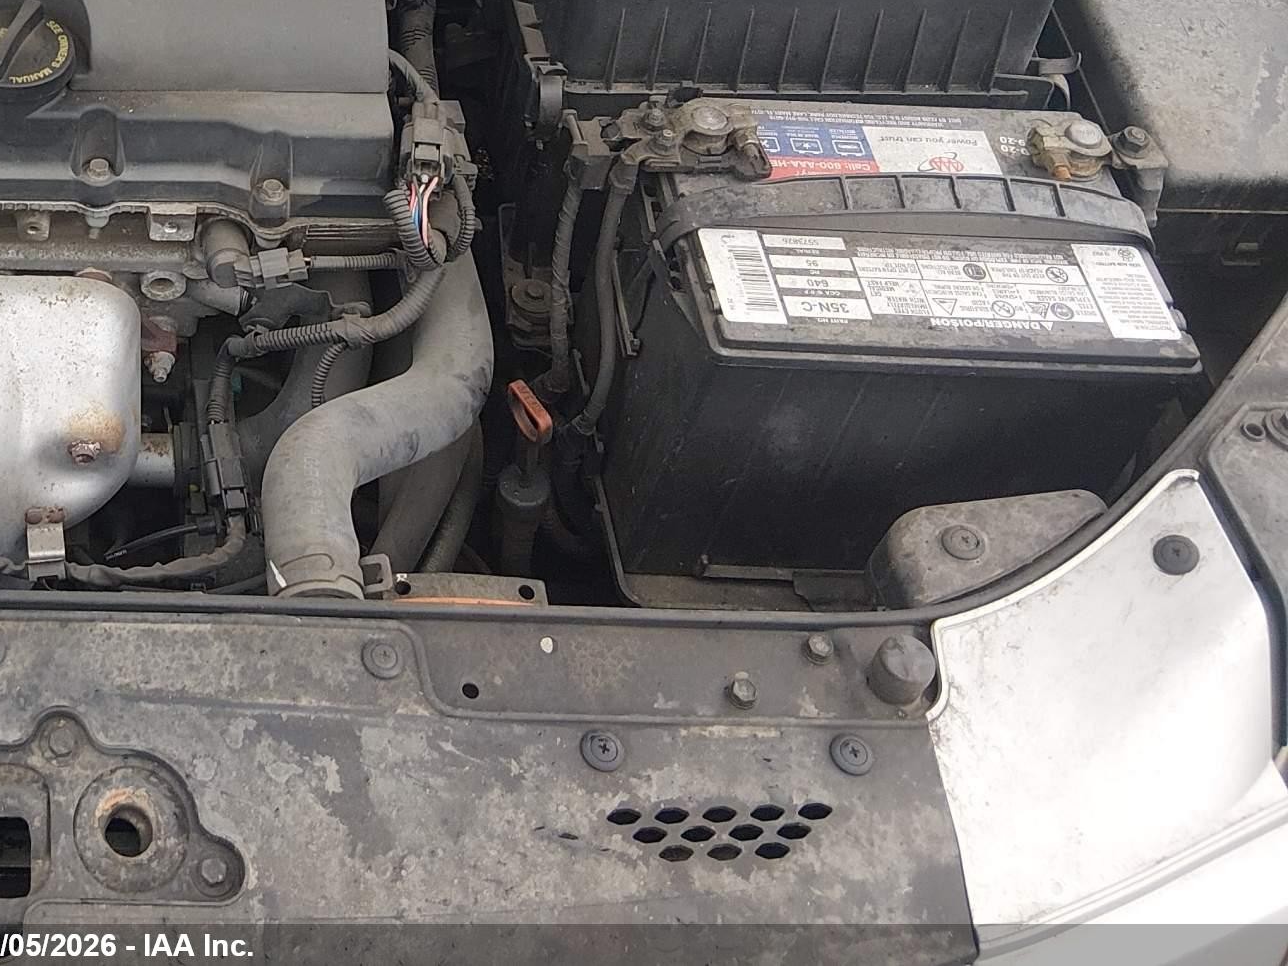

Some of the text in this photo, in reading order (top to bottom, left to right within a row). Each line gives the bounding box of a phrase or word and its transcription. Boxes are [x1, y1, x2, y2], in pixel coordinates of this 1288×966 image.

[45, 20, 64, 34] SEE
[8, 67, 53, 84] MANUAL
[925, 136, 944, 145] you
[946, 138, 978, 147] Power
[769, 158, 871, 171] Call: 800-AAA-HE
[930, 157, 961, 172] AAA
[806, 259, 818, 267] 95
[806, 279, 829, 288] 640
[801, 301, 849, 314] 35N-C
